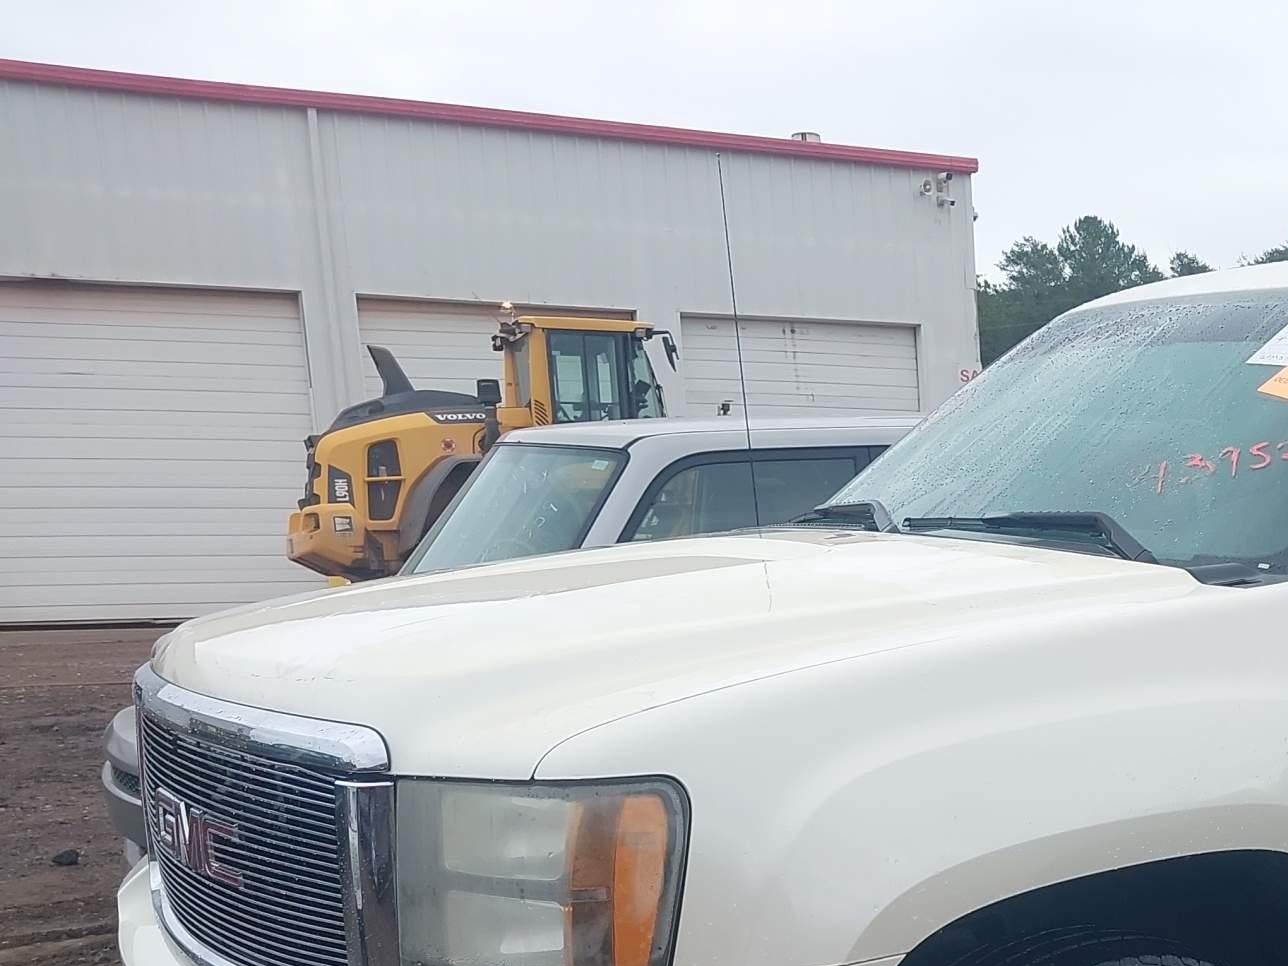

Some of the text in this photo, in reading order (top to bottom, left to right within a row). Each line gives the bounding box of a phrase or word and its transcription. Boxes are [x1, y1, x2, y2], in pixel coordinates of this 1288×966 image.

[434, 413, 486, 421] VOLVO
[334, 478, 350, 501] L90H
[155, 787, 244, 888] GMC
